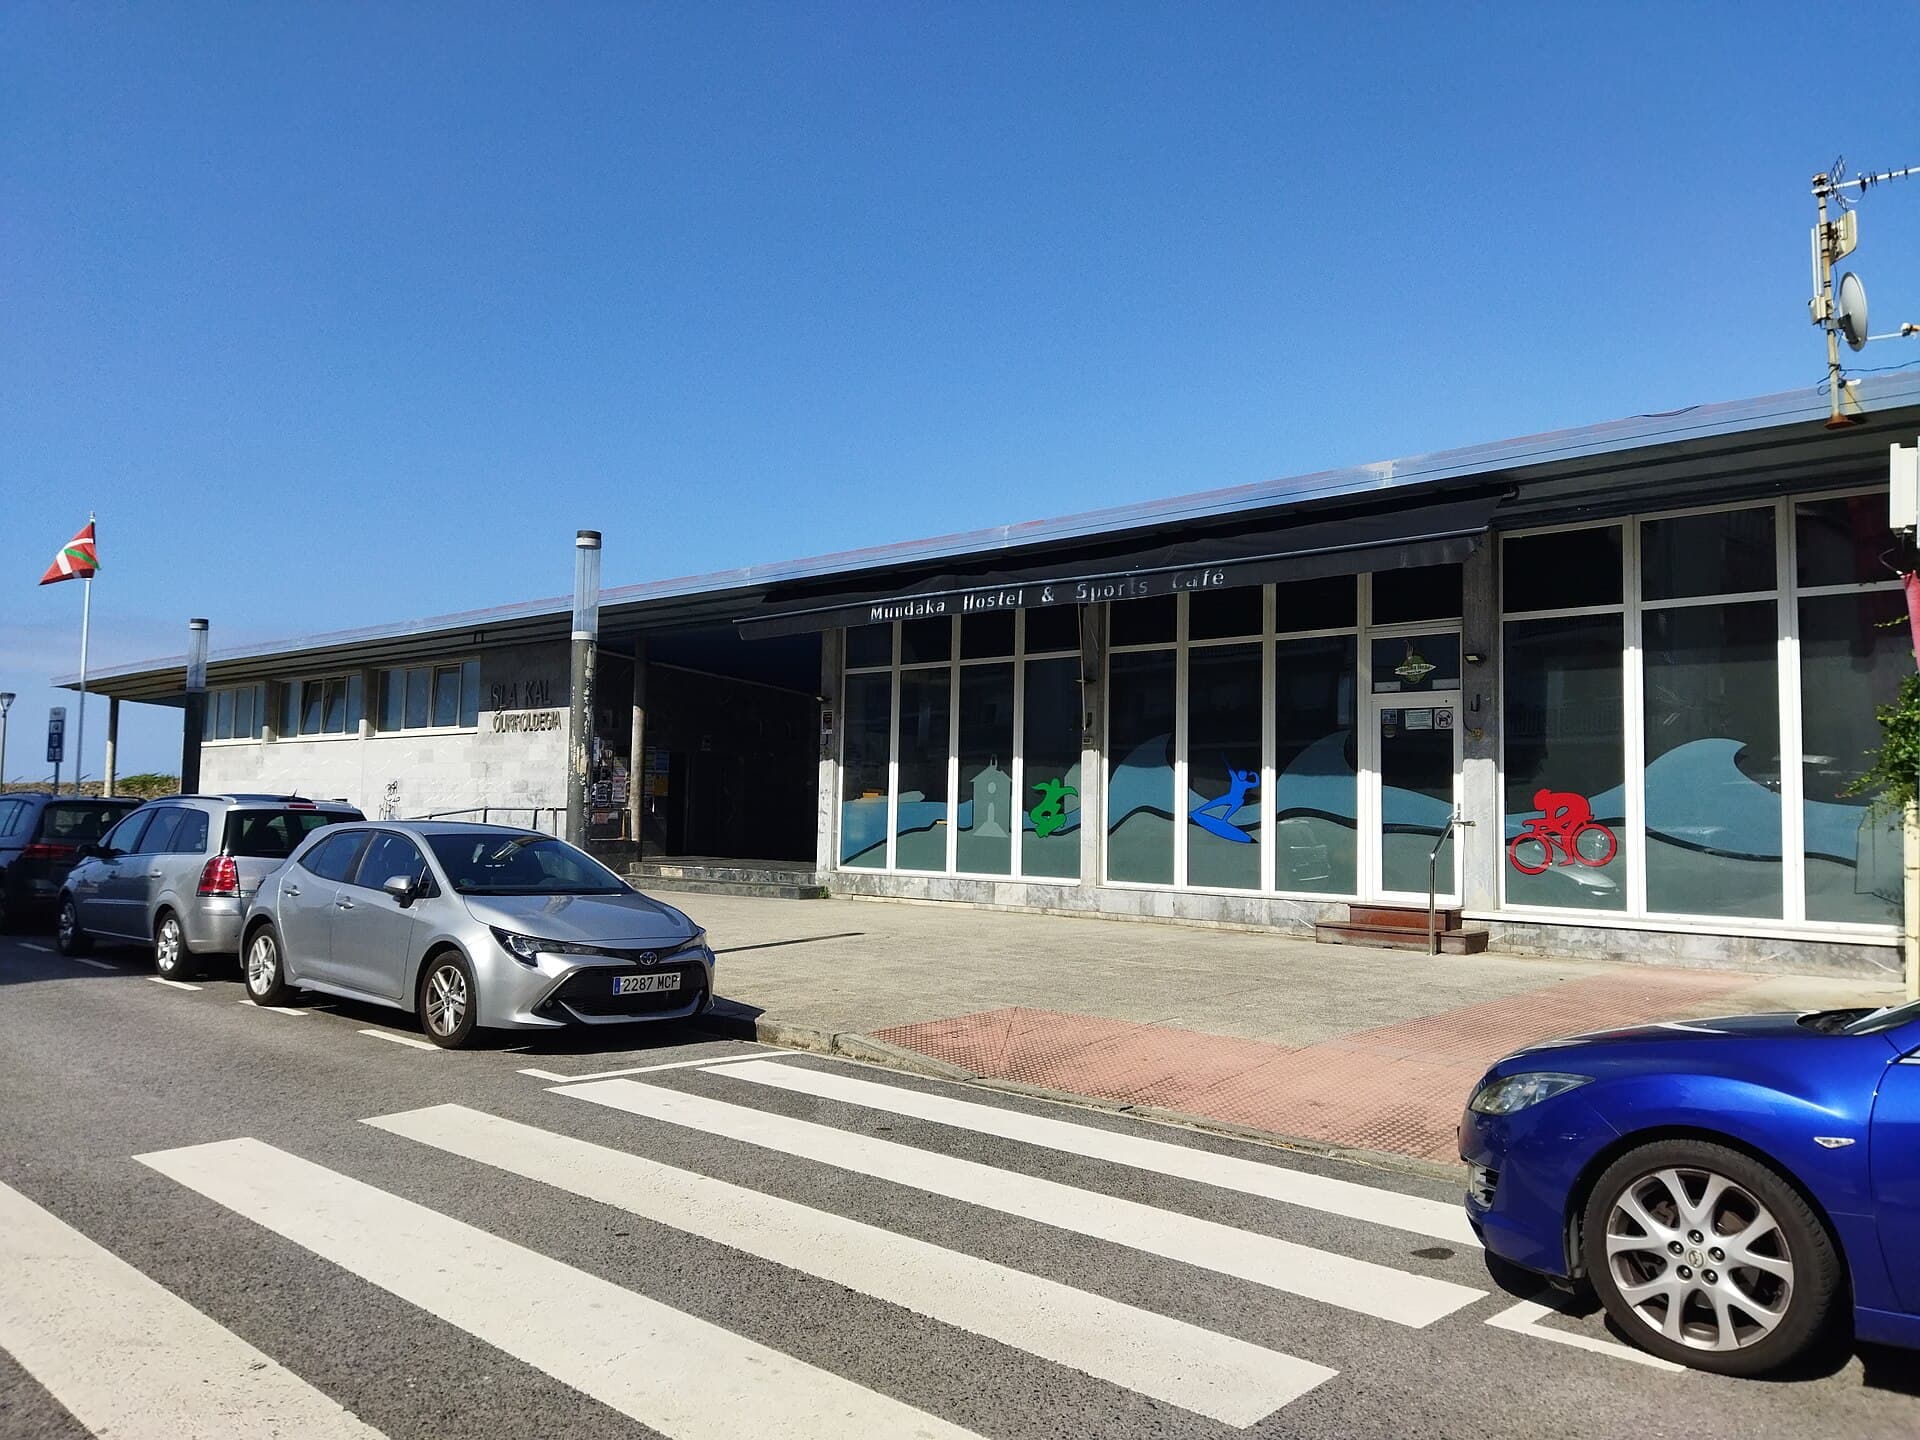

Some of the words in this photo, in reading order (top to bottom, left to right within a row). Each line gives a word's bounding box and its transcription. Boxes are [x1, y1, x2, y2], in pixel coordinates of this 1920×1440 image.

[870, 600, 945, 620] Mundaka
[963, 590, 1023, 610] Hostel
[1041, 586, 1055, 602] &
[1075, 577, 1149, 602] Sports
[623, 977, 654, 992] 2287
[657, 975, 678, 990] MCP
